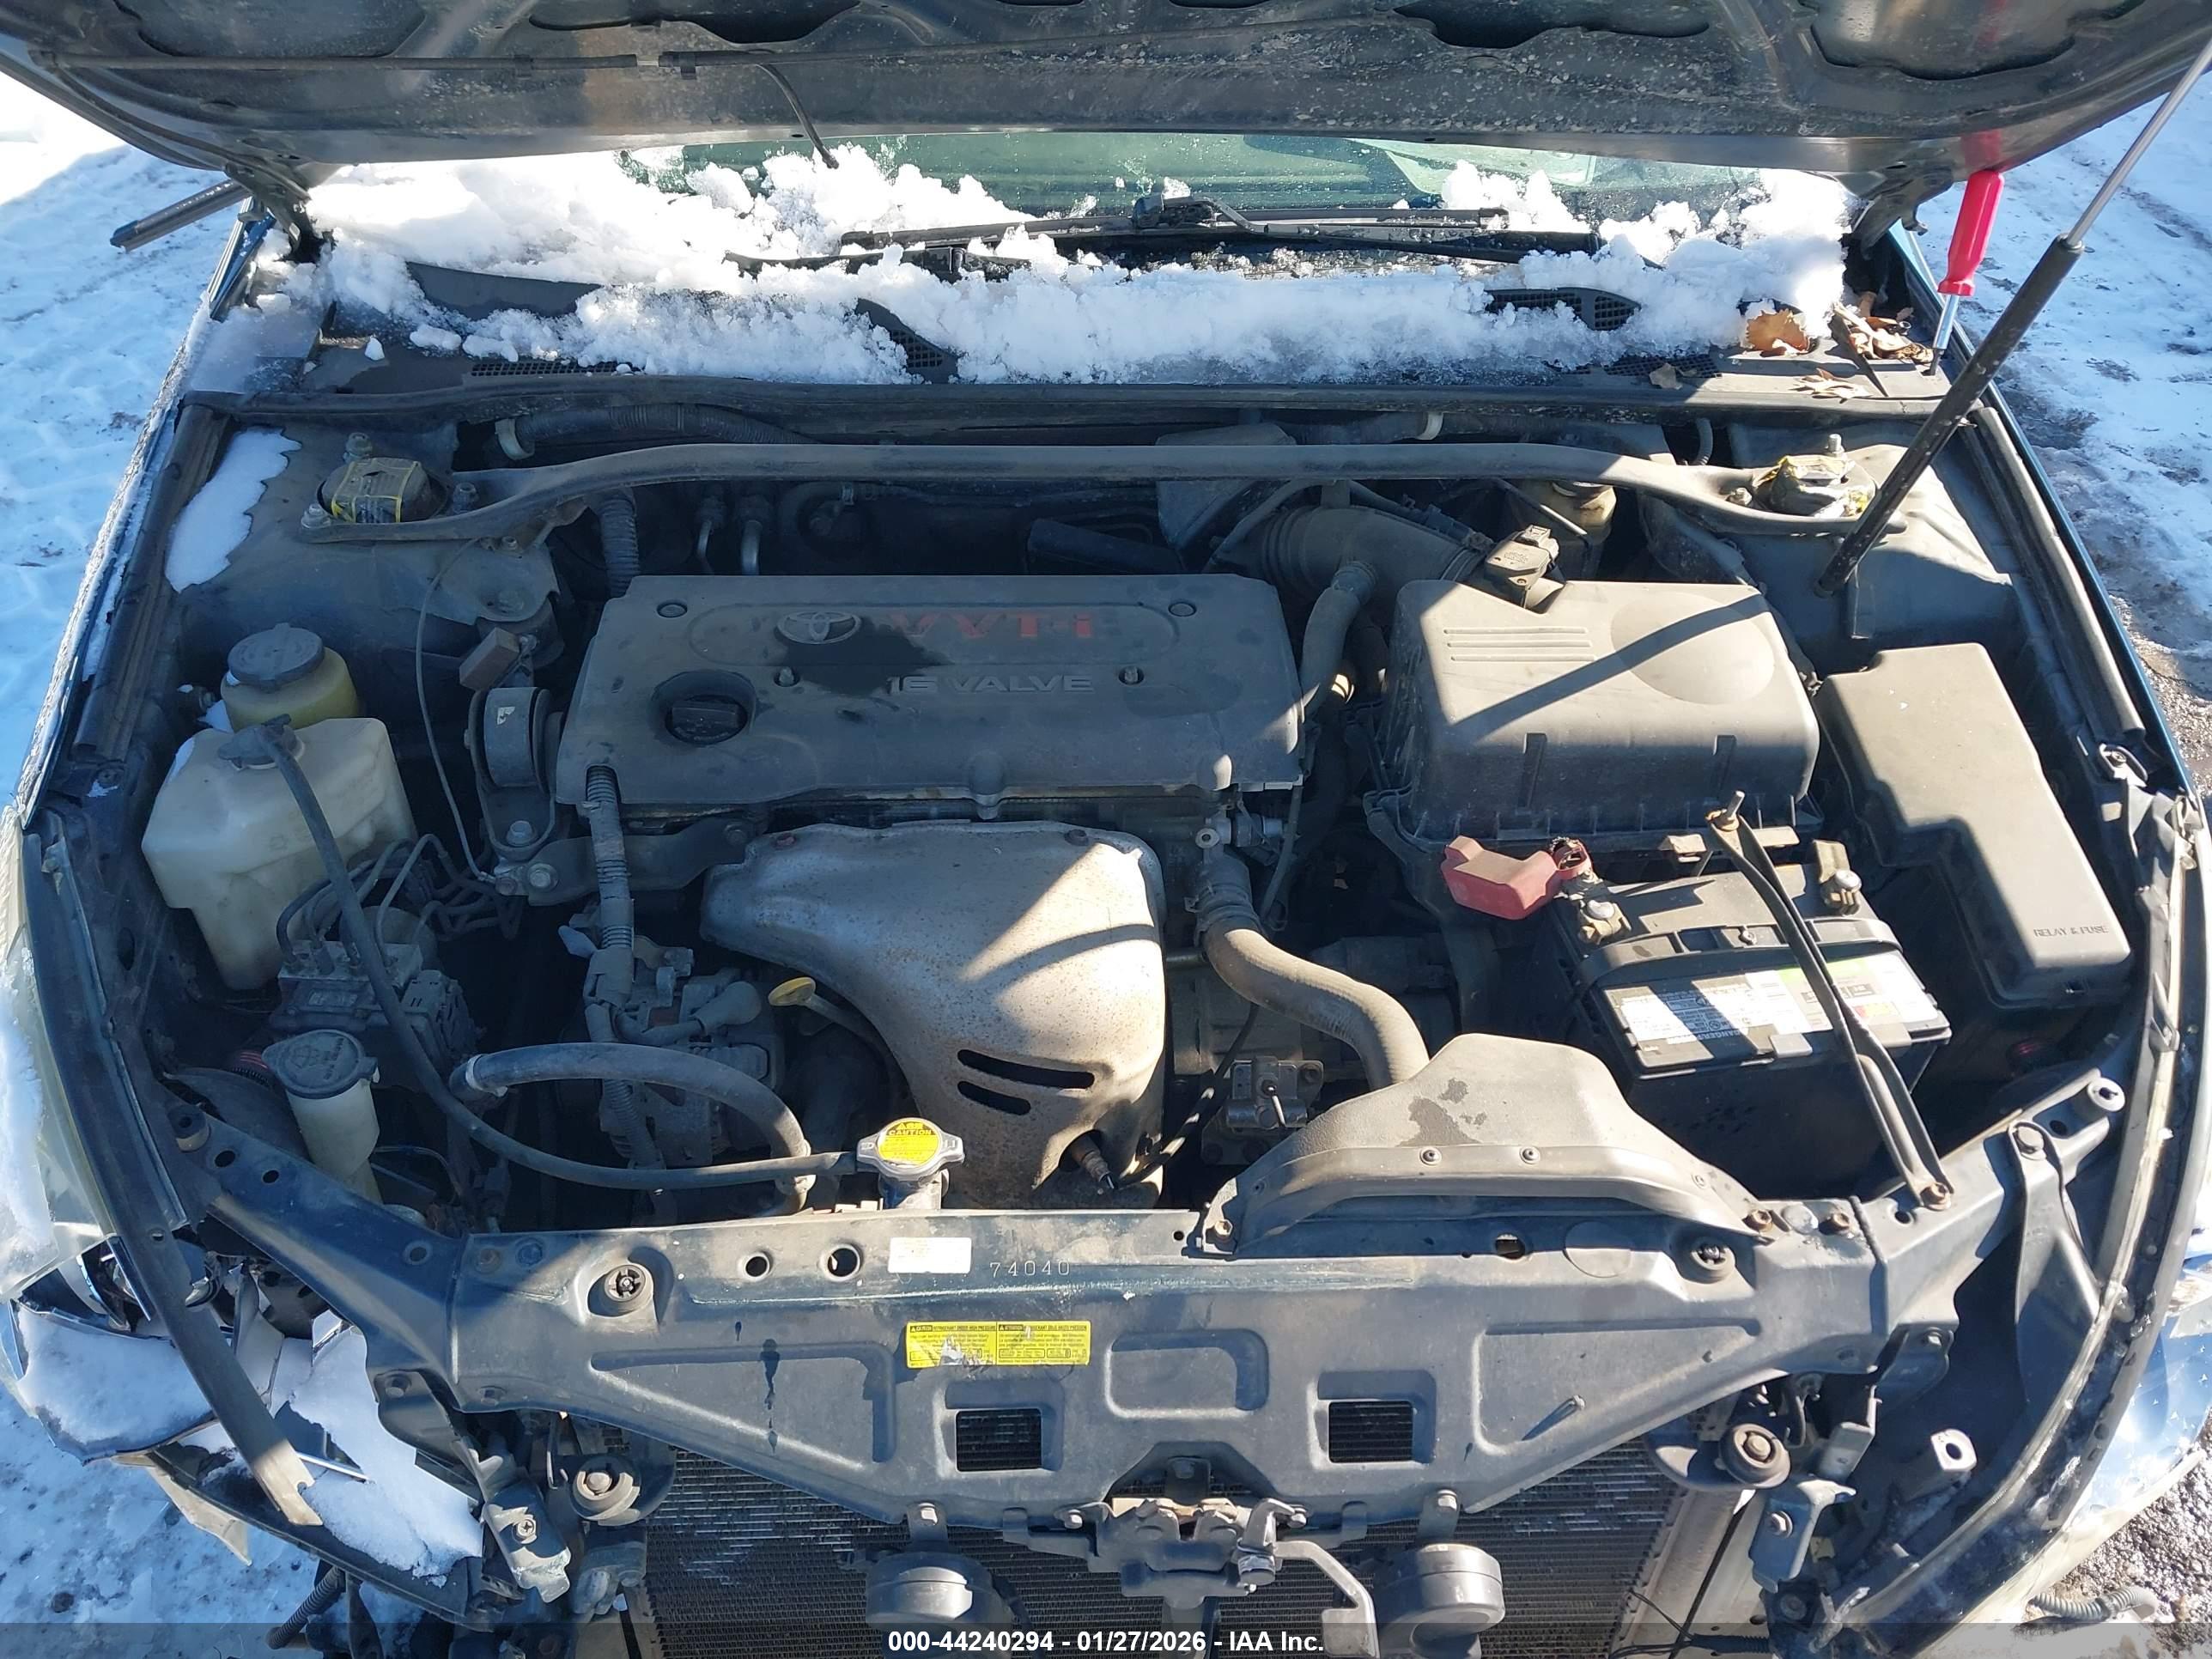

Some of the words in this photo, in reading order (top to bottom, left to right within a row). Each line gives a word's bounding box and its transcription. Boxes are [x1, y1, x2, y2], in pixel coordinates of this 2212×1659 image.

[885, 674, 938, 695] 16
[948, 674, 1096, 693] VALVE
[2033, 927, 2068, 938] RELAY
[2069, 927, 2080, 936] &
[2080, 925, 2110, 935] FUSE
[988, 1260, 1071, 1279] 74040
